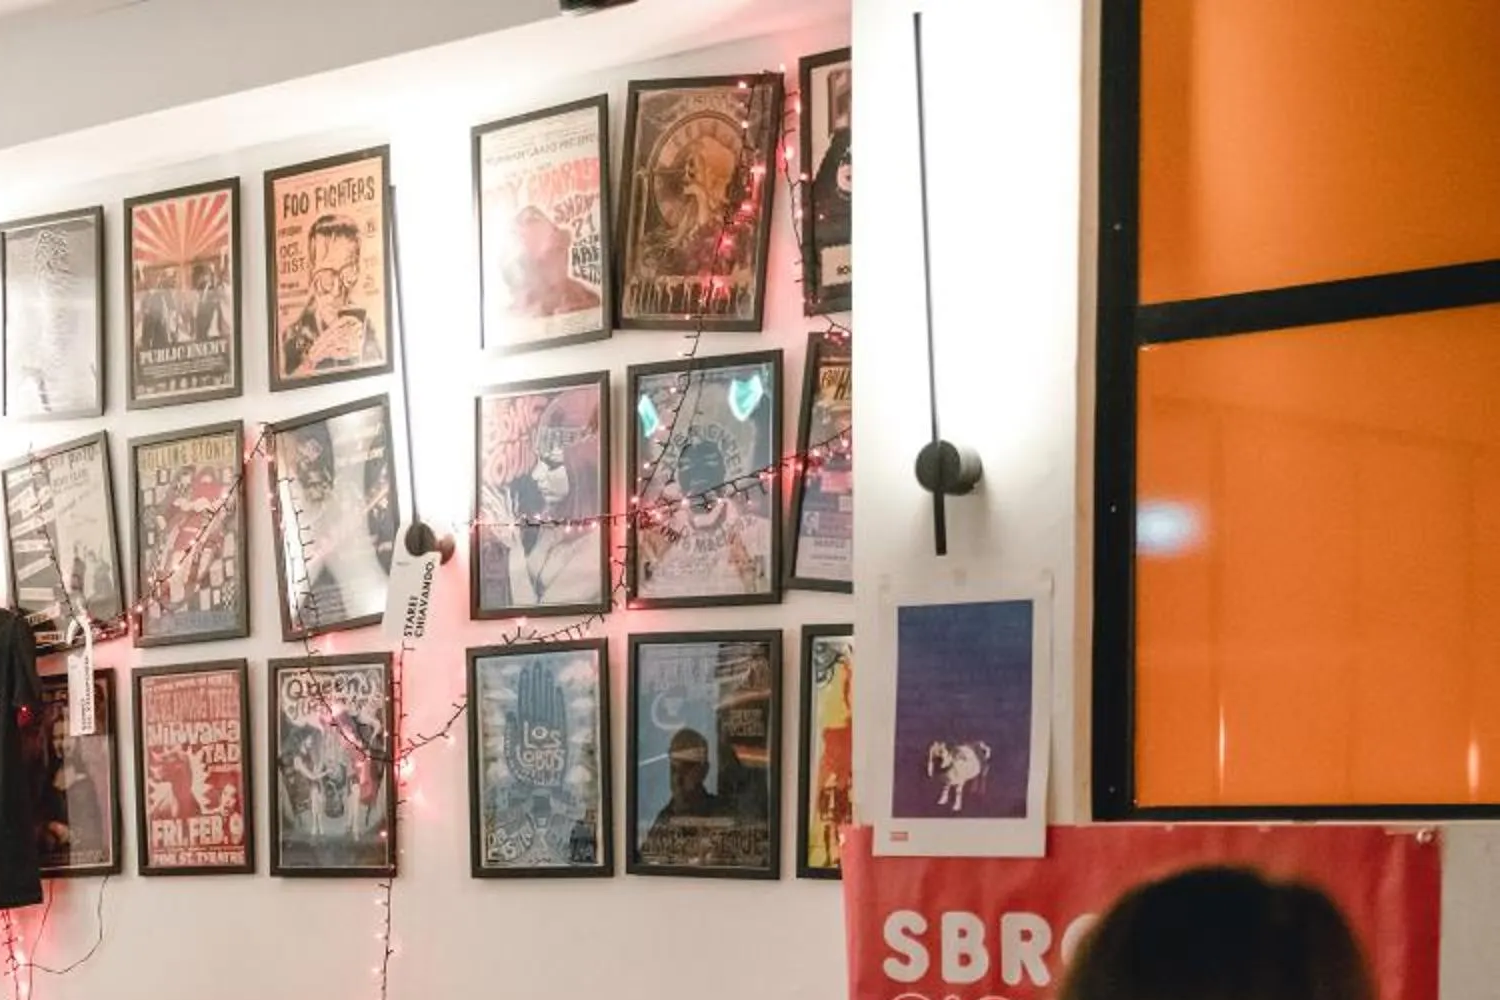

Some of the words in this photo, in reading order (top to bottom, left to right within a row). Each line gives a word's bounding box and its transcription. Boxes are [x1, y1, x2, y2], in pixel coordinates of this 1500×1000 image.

[283, 192, 309, 218] FOO
[315, 176, 375, 210] FIGHTERS
[140, 346, 184, 365] PUBLIC
[187, 340, 227, 359] ENEMY
[202, 743, 240, 763] TAD
